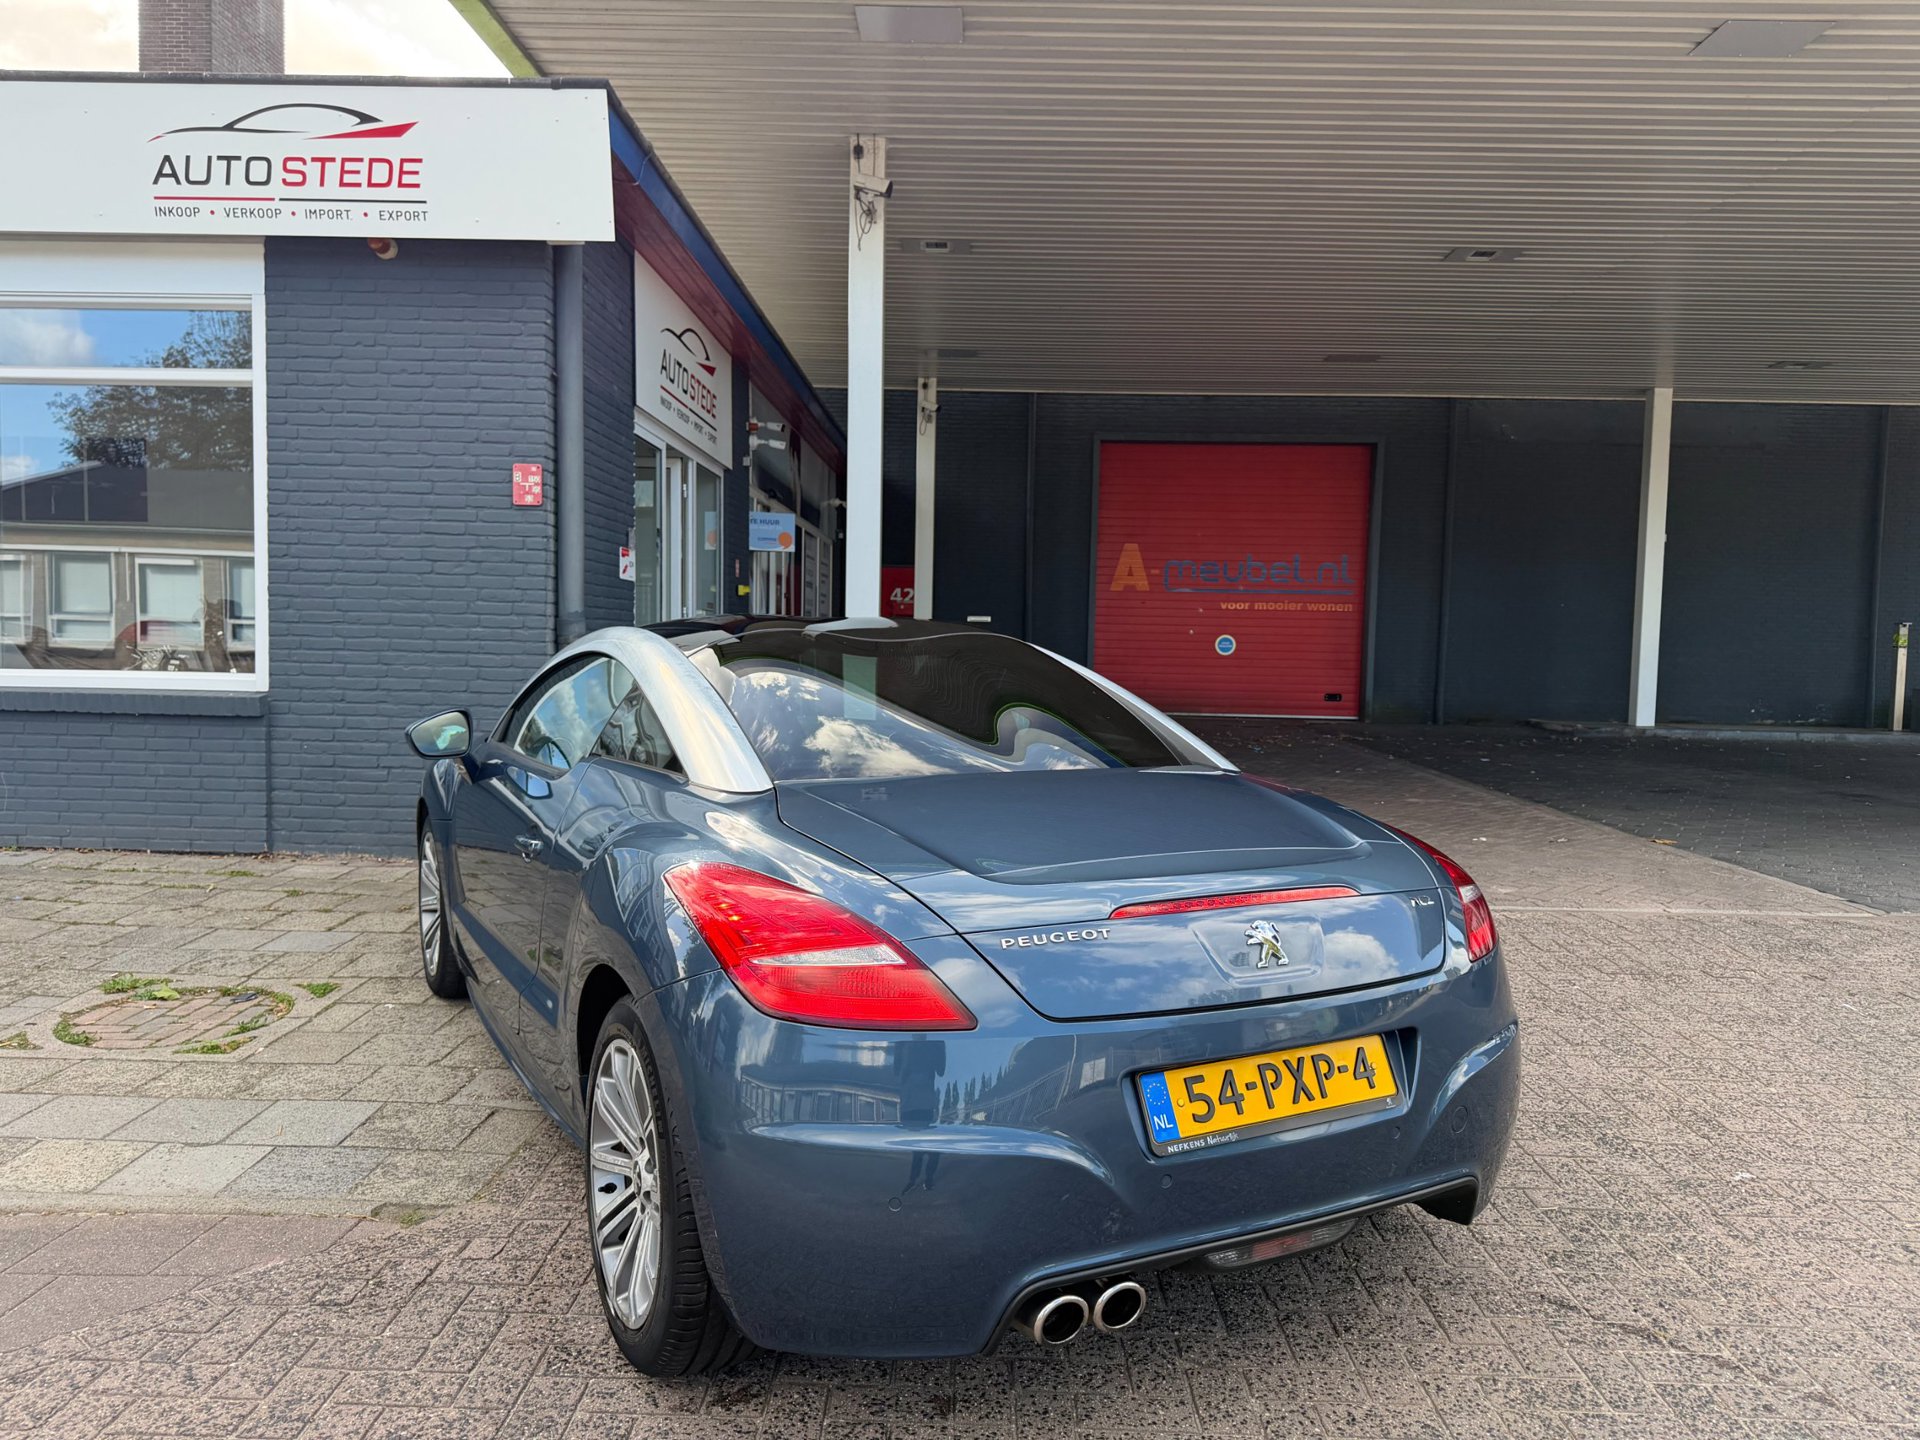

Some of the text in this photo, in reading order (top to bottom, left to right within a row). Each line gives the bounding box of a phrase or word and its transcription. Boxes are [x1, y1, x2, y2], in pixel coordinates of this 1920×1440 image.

[154, 206, 429, 222] INKOOP VERKOOP IMPORT EXPORT
[1220, 599, 1353, 613] voor mooier wonen
[1001, 928, 1111, 949] PEUGEOT
[1183, 1046, 1376, 1124] 54-PXP-4
[1153, 1114, 1174, 1131] NL
[1167, 1139, 1205, 1153] NEFKENS
